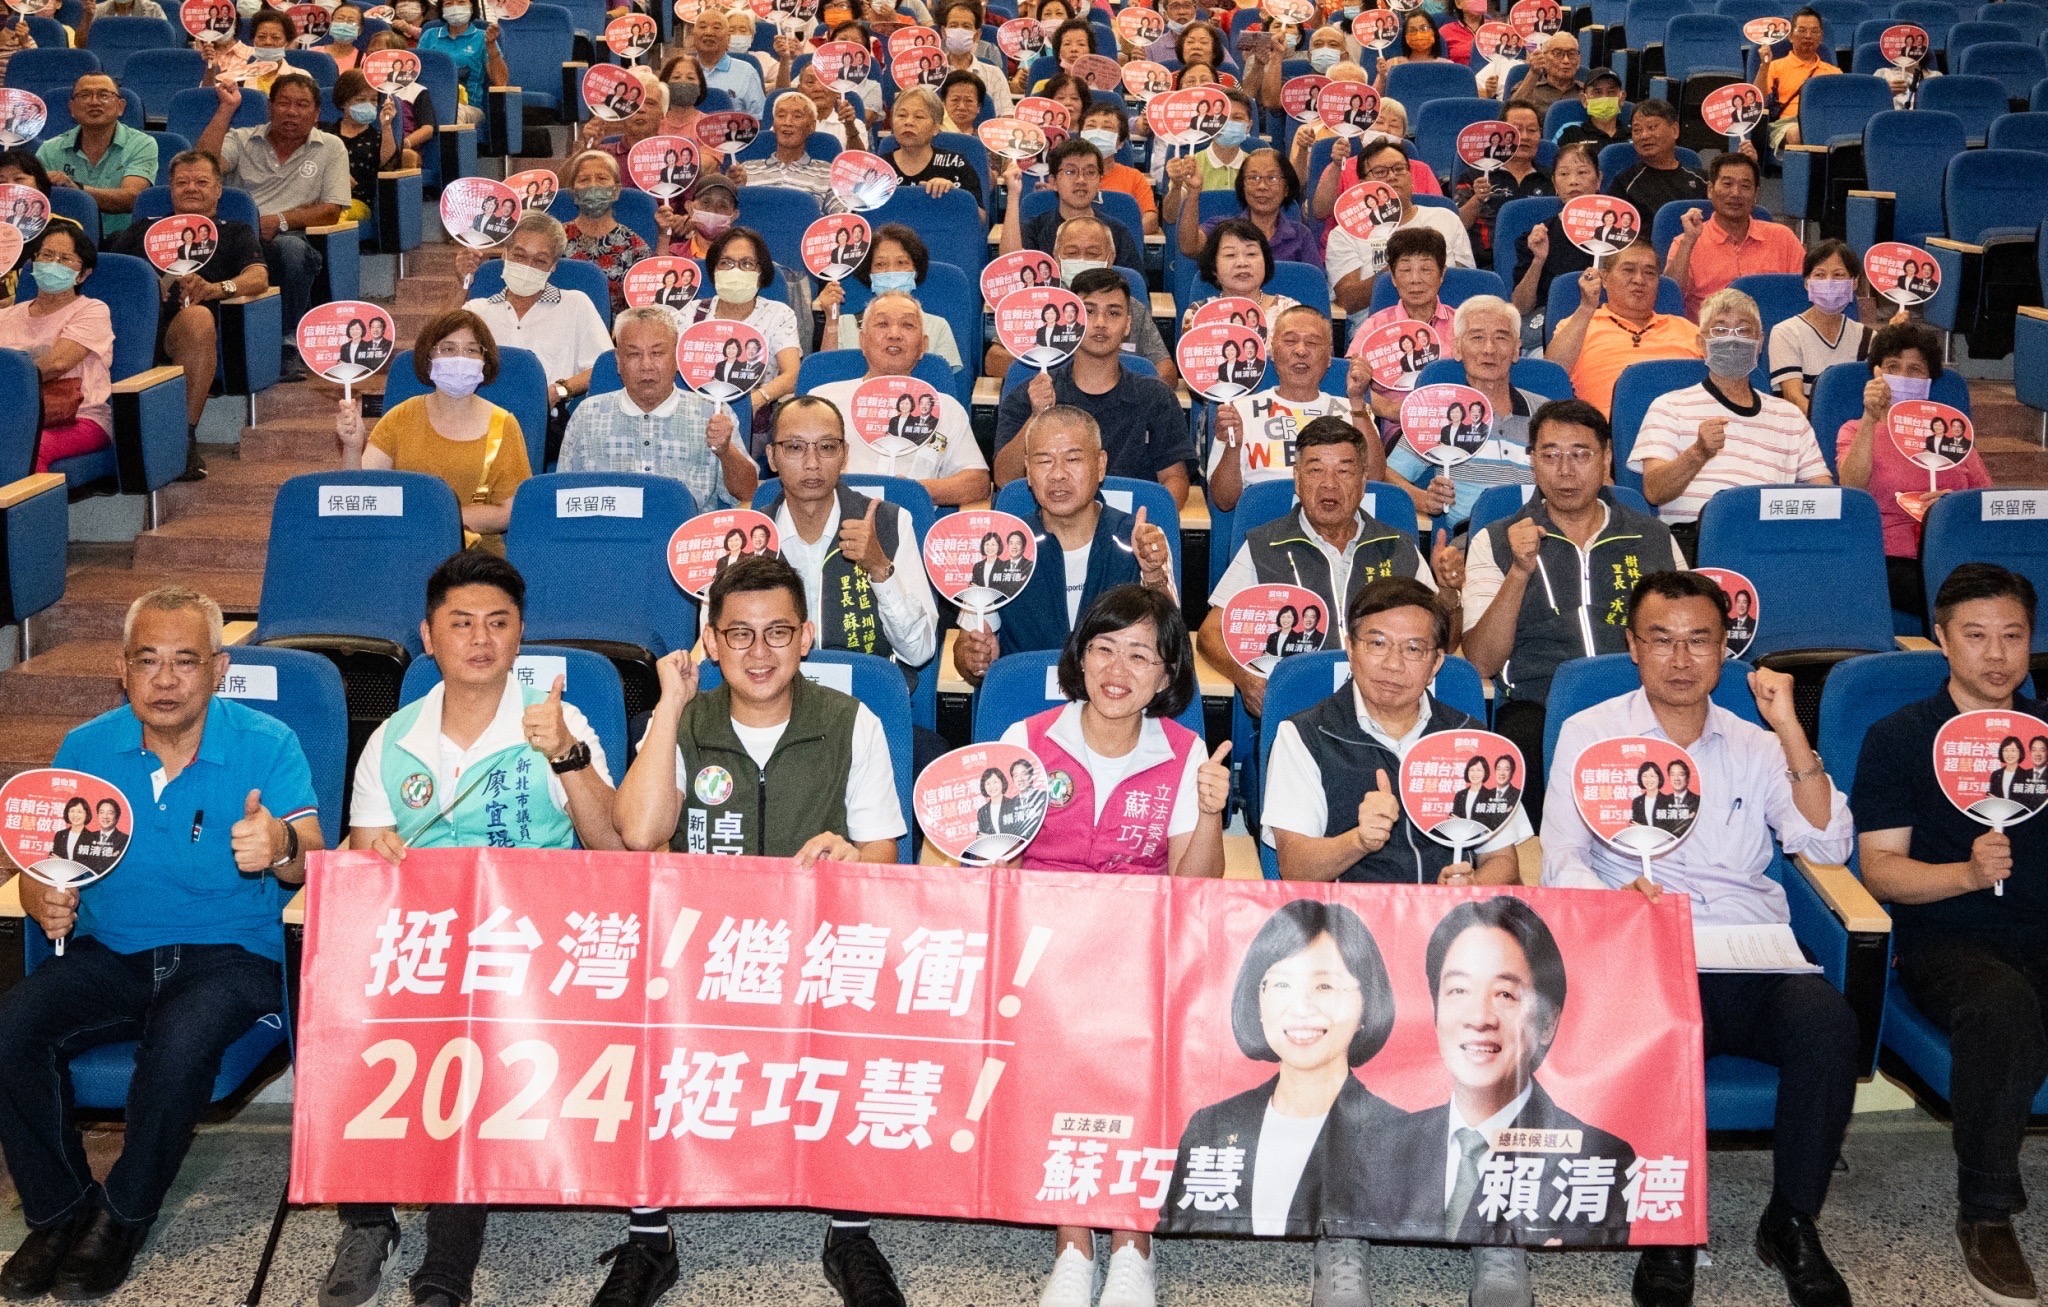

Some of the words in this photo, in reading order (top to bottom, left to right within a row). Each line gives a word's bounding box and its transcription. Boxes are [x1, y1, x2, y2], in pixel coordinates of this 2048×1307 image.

[327, 494, 378, 513] 保留席
[565, 495, 617, 514] 保留席
[1768, 500, 1816, 516] 保留席
[1989, 500, 2036, 517] 保留席
[992, 572, 1021, 582] 賴清德
[1612, 564, 1627, 590] 里長
[840, 576, 854, 608] 里長
[1066, 583, 1087, 594] sporti
[1285, 643, 1312, 652] 賴清德
[212, 674, 247, 694] 留席
[2012, 783, 2045, 794] 賴清德
[515, 757, 532, 841] 新北市議員
[1475, 803, 1507, 813] 賴清德
[1112, 790, 1151, 858] 蘇巧
[1141, 783, 1171, 858] 立法委員
[1655, 809, 1690, 820] 賴清德
[690, 813, 706, 854] 新北
[711, 811, 744, 855] 卓
[77, 844, 113, 857] 賴清德
[364, 906, 1053, 1019] 挺台灣！繼續衝！
[1060, 1116, 1122, 1136] 立法委員
[1498, 1131, 1575, 1151] 總統候選人
[1034, 1138, 1246, 1212] 蘇巧慧
[1477, 1154, 1690, 1225] 賴清德
